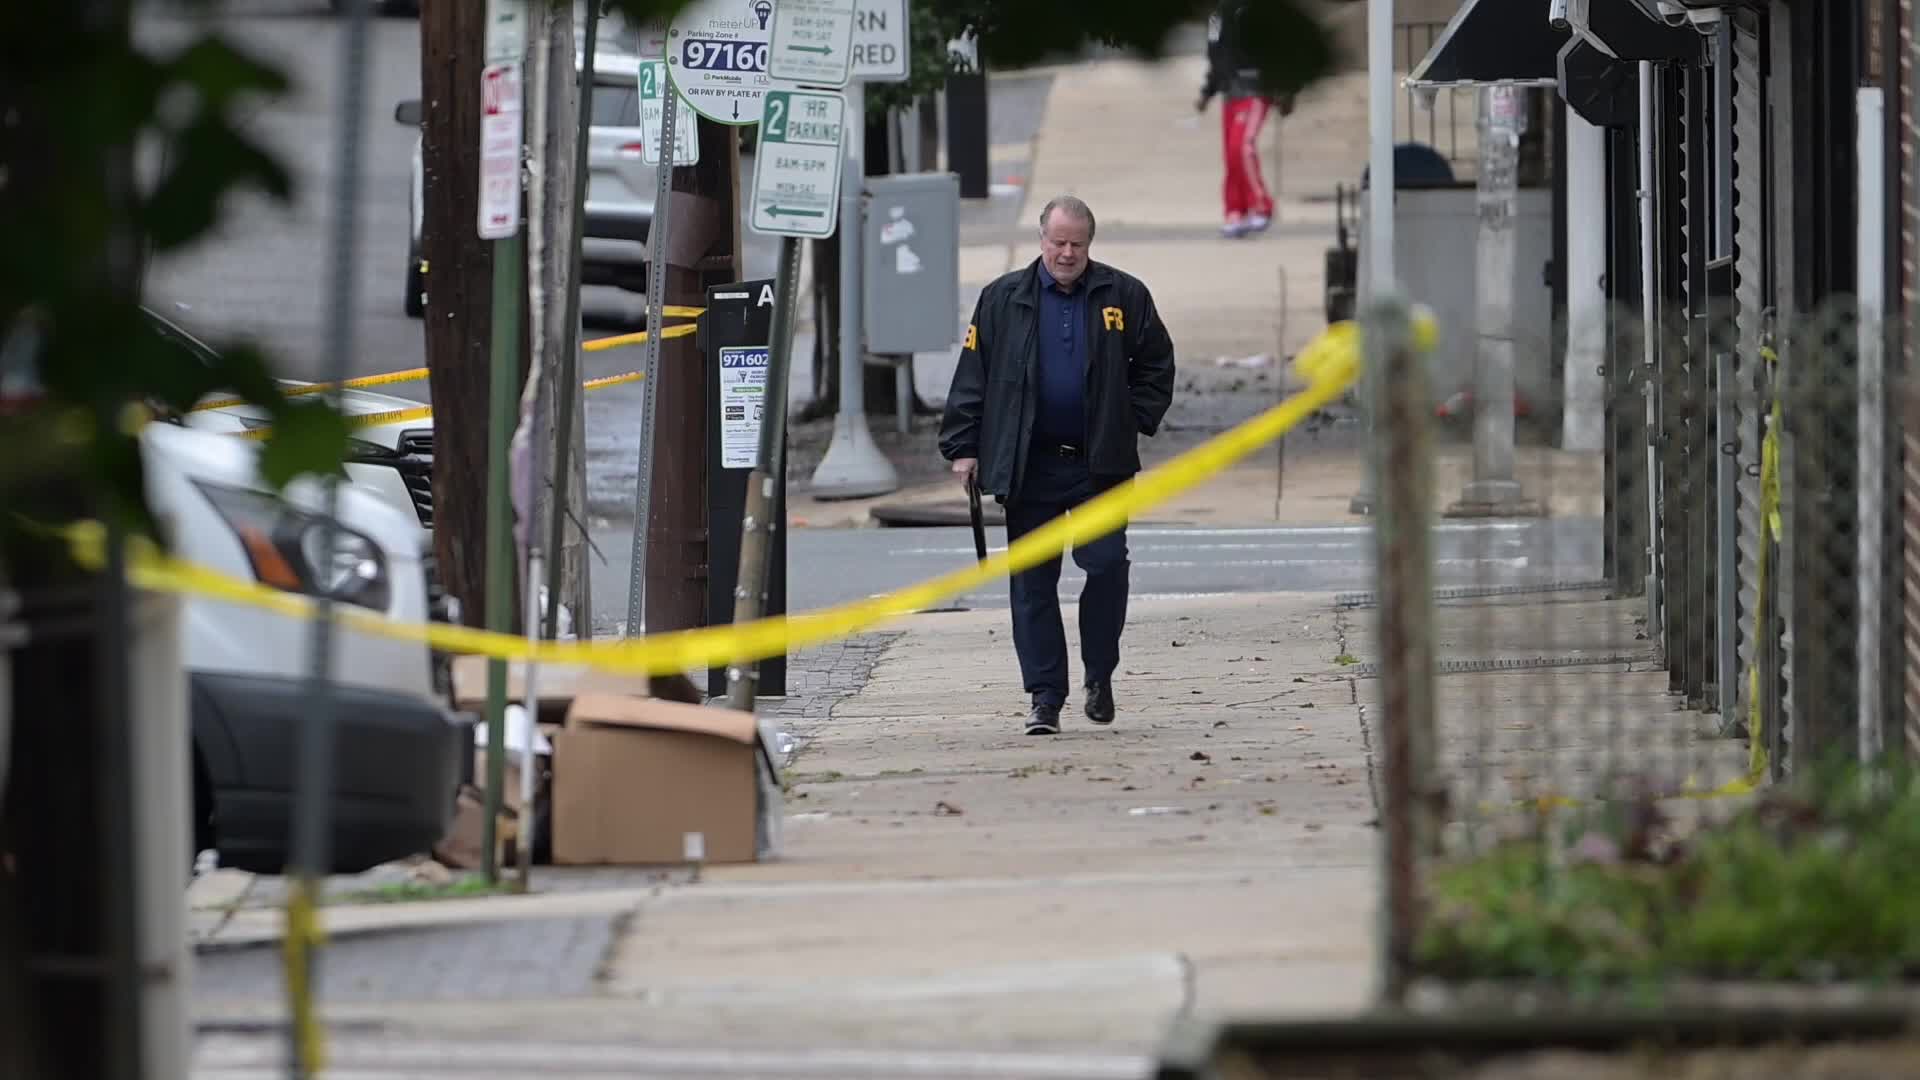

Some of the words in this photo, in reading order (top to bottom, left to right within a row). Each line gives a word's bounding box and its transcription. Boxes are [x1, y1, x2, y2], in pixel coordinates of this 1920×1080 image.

[708, 17, 759, 29] meterUP
[687, 30, 714, 39] Parking
[852, 43, 896, 65] RED
[642, 67, 653, 95] 2
[688, 87, 699, 95] OR
[700, 88, 715, 96] PAY
[716, 89, 726, 97] BY
[727, 90, 751, 98] PLATE
[766, 99, 785, 135] 2
[806, 100, 828, 117] HR
[788, 121, 840, 141] PARKING
[723, 353, 769, 367] 971602
